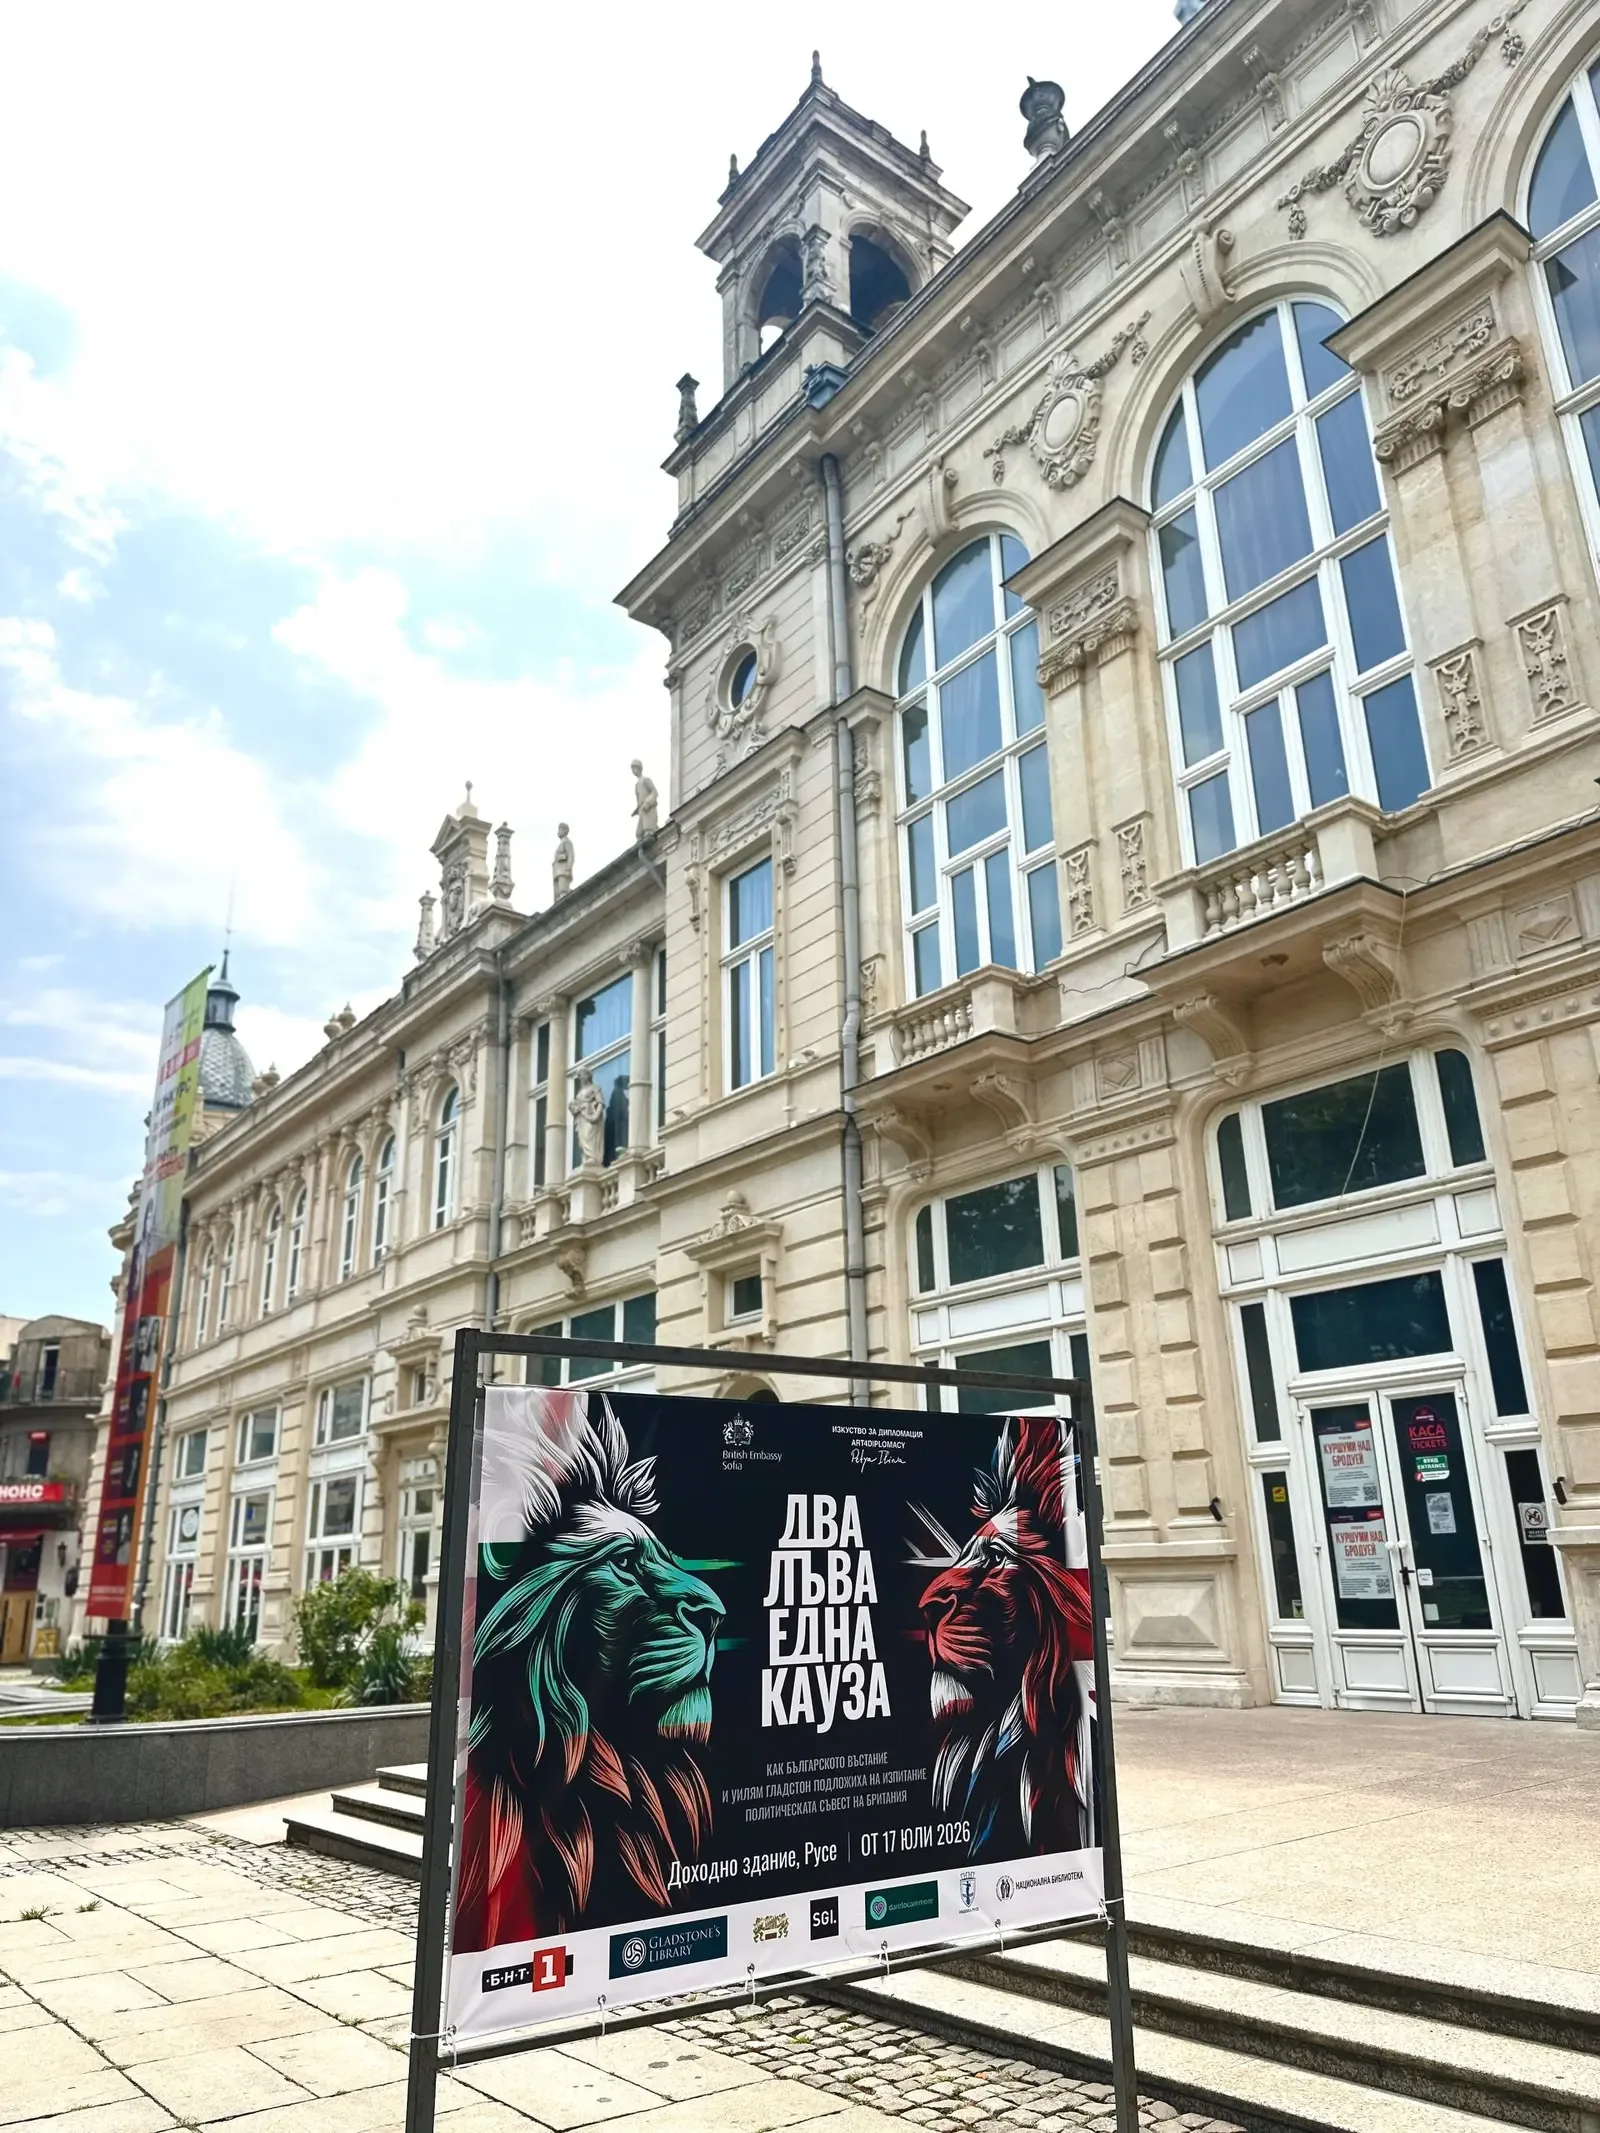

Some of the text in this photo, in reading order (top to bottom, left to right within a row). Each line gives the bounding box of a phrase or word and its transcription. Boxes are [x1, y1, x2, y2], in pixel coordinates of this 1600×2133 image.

[832, 1425, 867, 1436] ИЗКУСТВО
[878, 1429, 923, 1439] ДИПЛОМАЦИЯ
[1409, 1424, 1445, 1437] КАСА
[722, 1449, 782, 1463] British Embassy
[851, 1439, 906, 1449] ART4DIPLOMACY
[1411, 1439, 1447, 1449] TICKETS
[722, 1461, 742, 1471] Sofia
[778, 1493, 864, 1548] ДВА
[763, 1550, 878, 1607] ЛЪВА
[769, 1605, 877, 1666] ЕДНА
[761, 1662, 891, 1734] КАУЗА
[766, 1752, 888, 1777] КАК БЪЛГАРСКОТО ВЪСТАНИЕ
[722, 1767, 927, 1804] И УИЛЯМ ГЛАДСТОН ПОДЛОЖИХА НА ИЗПИТАНИЕ
[745, 1789, 907, 1822] ПОЛИТИЧЕСКАТА СЪВЕСТ НА БРИТАНИЯ
[860, 1820, 971, 1857] ОТ 17 ЮЛИ 2026
[667, 1840, 837, 1890] Доходно здание, Русе
[1015, 1871, 1083, 1890] НАЦИОНАЛНА БИБЛИОТЕКА
[812, 1909, 837, 1927] SGI.
[649, 1944, 693, 1963] LIBRARY
[540, 1954, 557, 1985] 1
